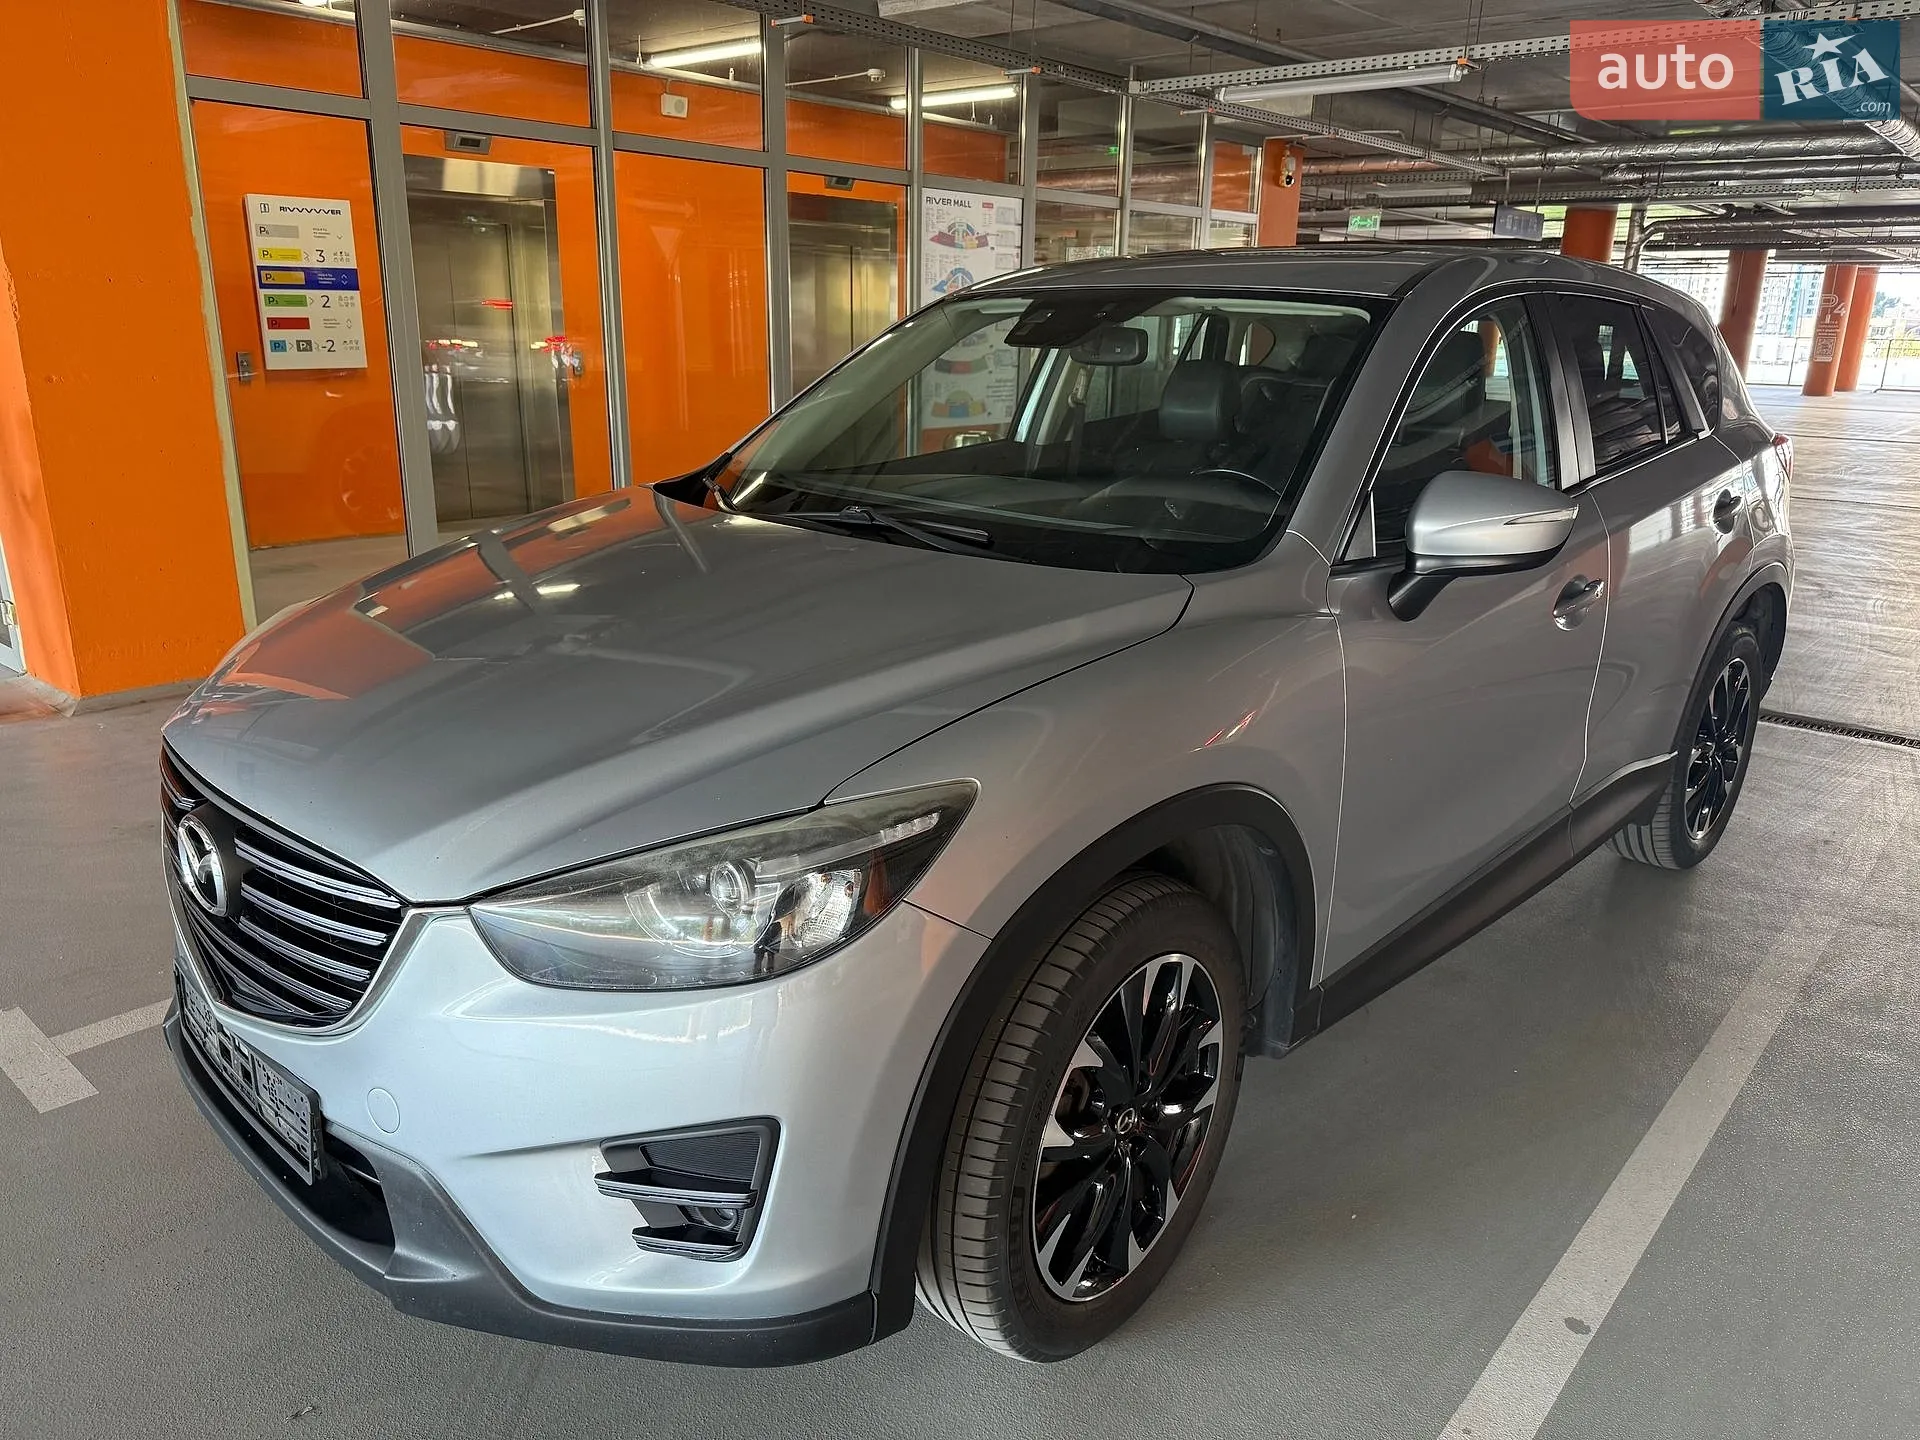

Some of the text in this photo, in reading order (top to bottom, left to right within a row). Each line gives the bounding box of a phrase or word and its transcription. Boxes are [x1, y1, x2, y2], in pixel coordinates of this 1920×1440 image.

[926, 196, 952, 206] RIVER
[953, 199, 971, 208] MALL
[315, 249, 325, 263] 3
[320, 294, 331, 308] 2
[321, 339, 336, 353] -2
